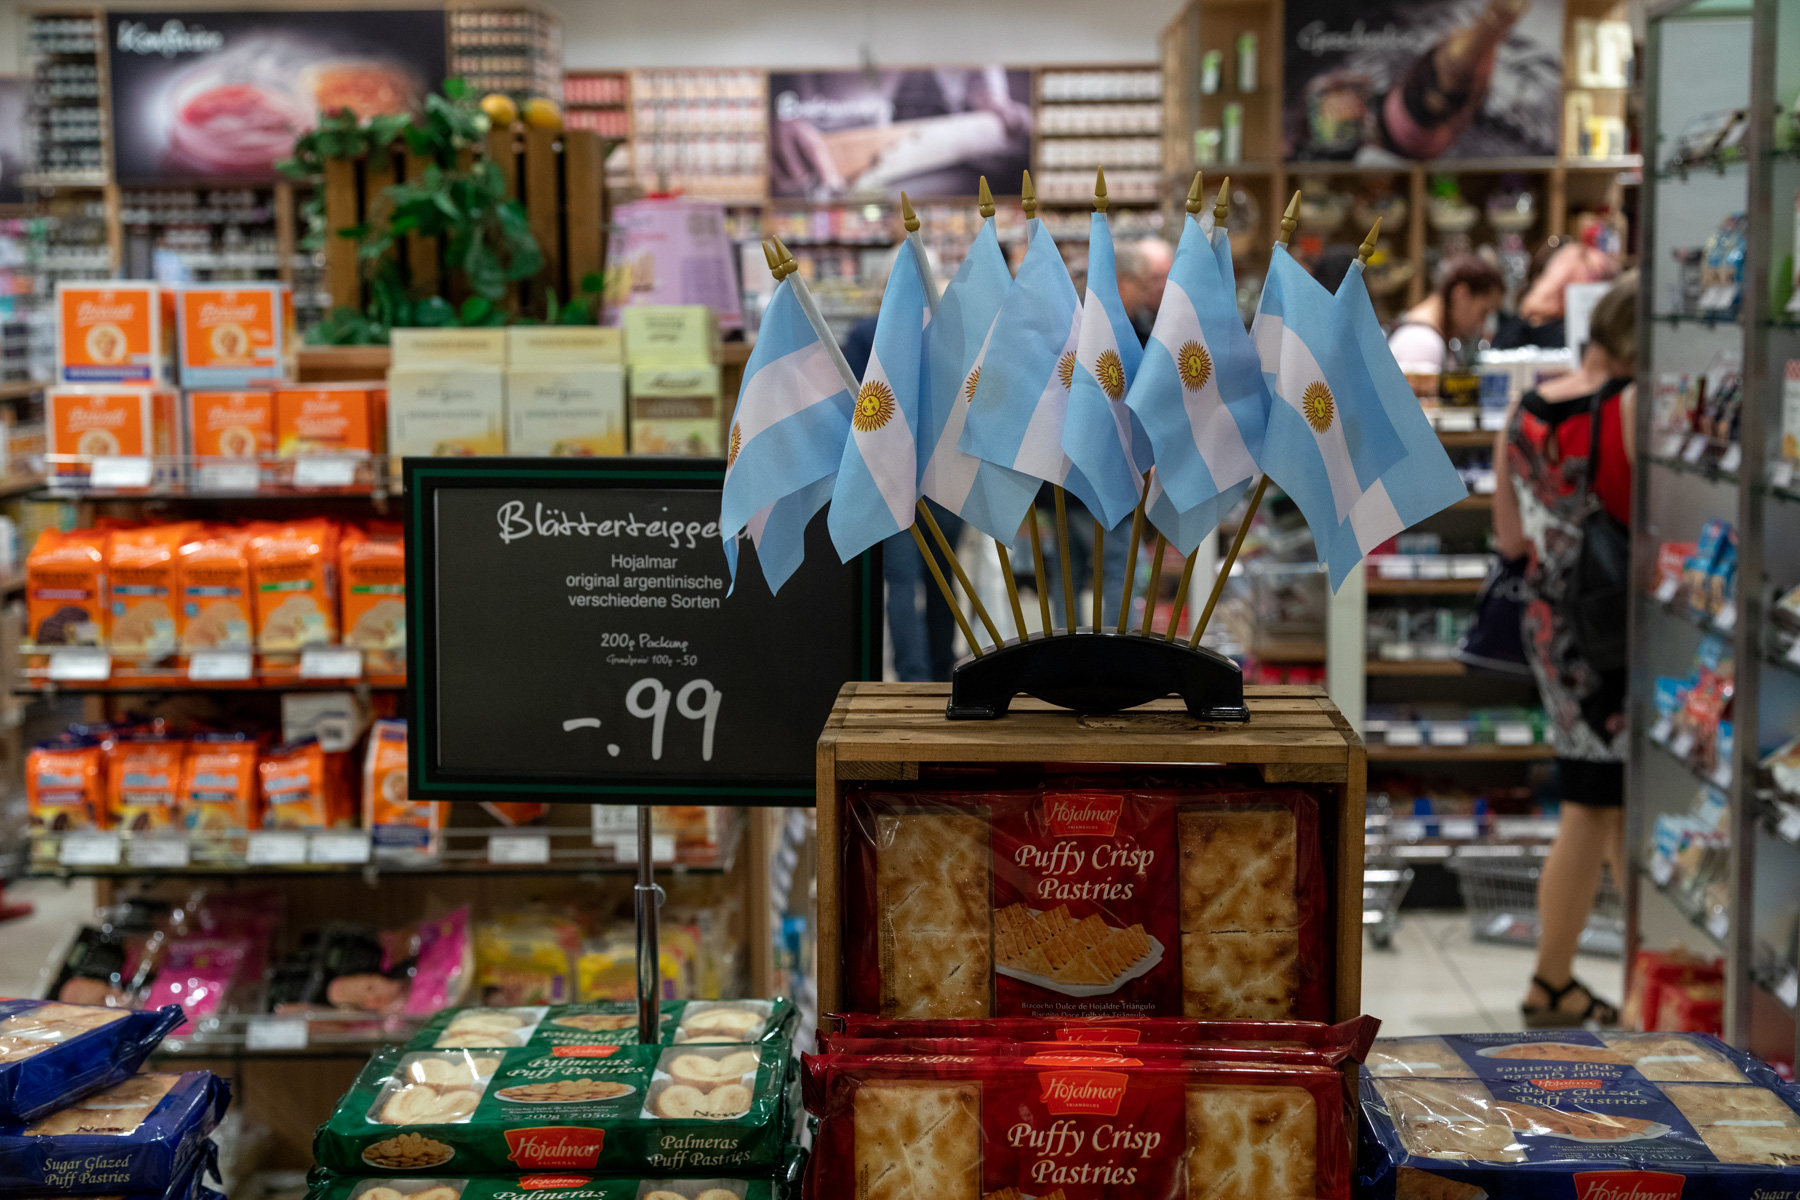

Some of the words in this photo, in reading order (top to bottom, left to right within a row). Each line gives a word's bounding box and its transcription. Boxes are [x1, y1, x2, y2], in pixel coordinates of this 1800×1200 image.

[611, 554, 678, 572] Hojalmar
[566, 573, 619, 590] original
[623, 574, 723, 591] argentinische
[568, 593, 667, 608] verschiedene
[671, 594, 720, 608] Sorten
[601, 633, 635, 651] 200g
[639, 633, 689, 652] Packung
[1048, 801, 1119, 825] Hojalmar
[1015, 841, 1085, 875] Puffy
[1091, 843, 1155, 875] Crisp
[1037, 877, 1134, 900] Pastries
[1021, 1002, 1053, 1010] Bizcocho
[1055, 1002, 1077, 1010] Dulce
[1078, 1002, 1087, 1010] de
[1089, 1002, 1120, 1011] Hojaldre
[1122, 1002, 1156, 1012] Triángulo
[528, 1057, 633, 1068] Palmeras
[1496, 1065, 1569, 1073] Pastries
[1571, 1063, 1616, 1073] Puff
[506, 1066, 563, 1079] Puff
[561, 1065, 646, 1076] Pastries
[1043, 1077, 1122, 1102] Hojalmar
[1572, 1088, 1643, 1098] Glazed
[1515, 1095, 1561, 1107] Puff
[1567, 1097, 1648, 1105] Pastries
[694, 1110, 740, 1118] New
[512, 1135, 600, 1161] Hojalmar
[660, 1134, 739, 1149] Palmeras
[1007, 1120, 1085, 1157] Puffy
[1092, 1124, 1161, 1159] Crisp
[43, 1157, 82, 1174] Sugar
[84, 1154, 133, 1172] Glazed
[649, 1150, 688, 1170] Puff
[689, 1150, 750, 1167] Pastries
[45, 1171, 76, 1189] Puff
[79, 1170, 130, 1185] Pastries
[1031, 1159, 1138, 1185] Pastries
[493, 1189, 609, 1200] Palmeras
